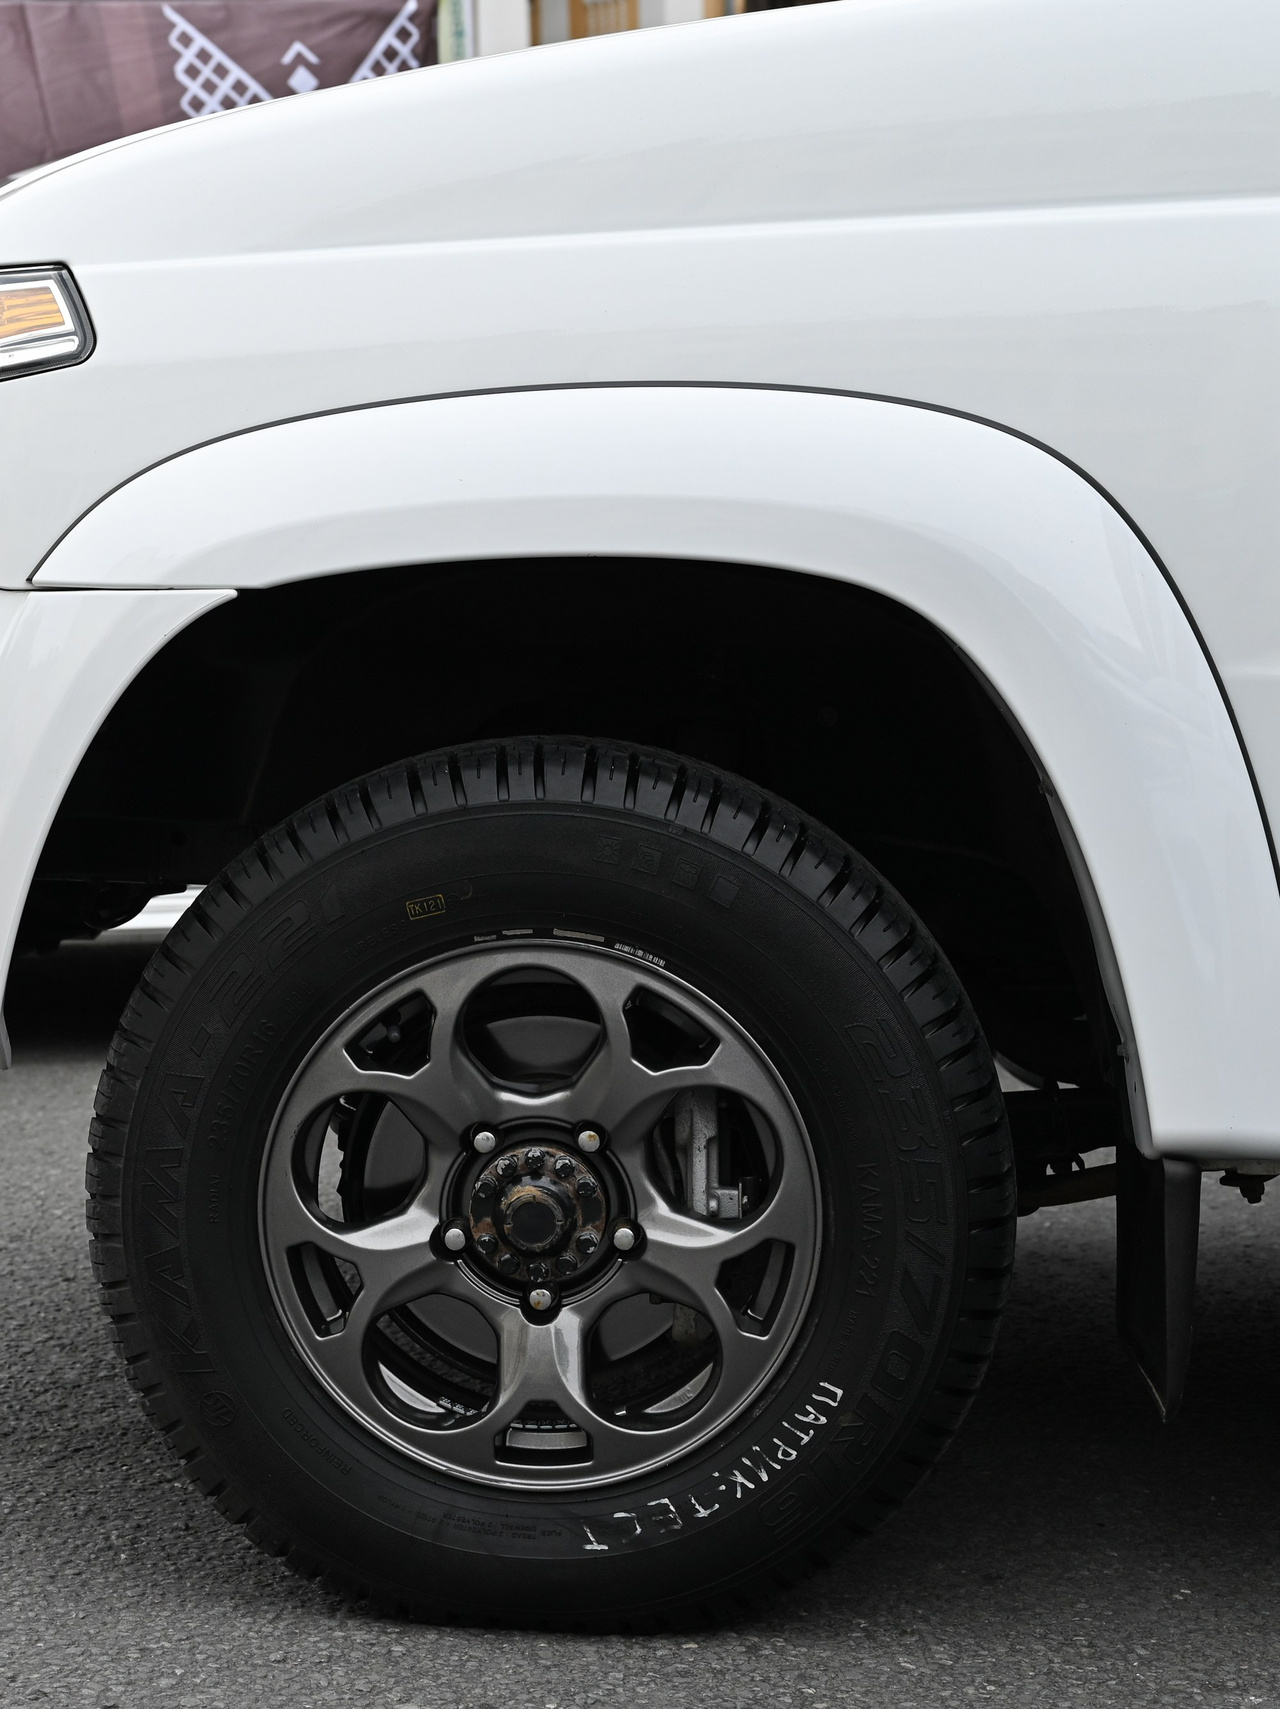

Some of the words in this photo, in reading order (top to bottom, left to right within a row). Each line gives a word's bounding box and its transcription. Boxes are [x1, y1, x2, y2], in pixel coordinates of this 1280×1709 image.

[406, 893, 444, 921] TK121
[143, 879, 353, 1388] KAMA-221
[208, 1017, 277, 1149] 235/70R16
[207, 1171, 222, 1224] RADIAL
[757, 1017, 948, 1544] 235/70R16
[278, 1404, 354, 1478] REINFORCED
